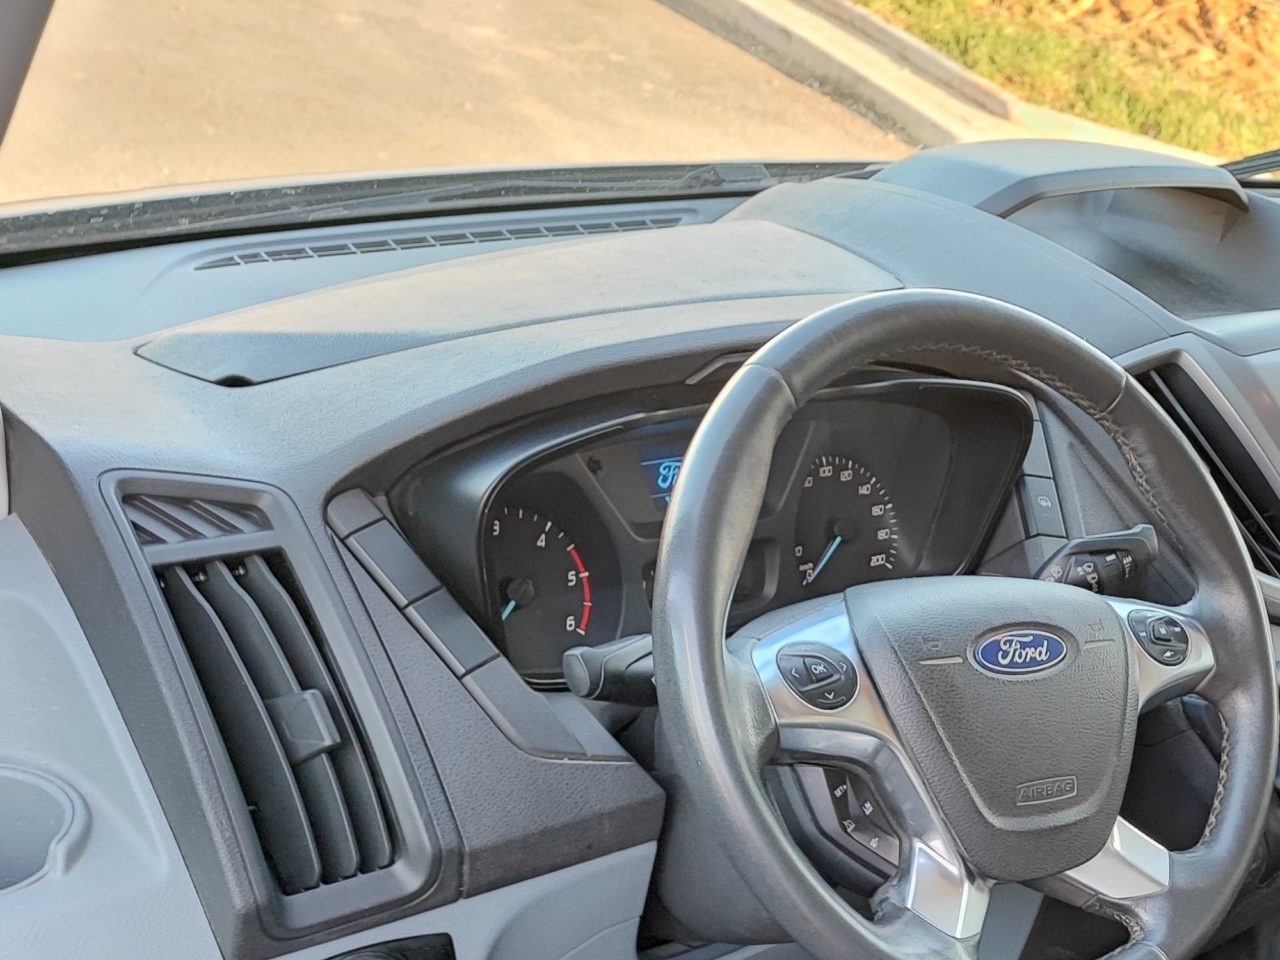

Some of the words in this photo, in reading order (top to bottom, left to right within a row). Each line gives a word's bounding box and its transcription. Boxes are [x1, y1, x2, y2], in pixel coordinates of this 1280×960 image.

[819, 465, 833, 477] 100
[492, 520, 500, 536] 3
[536, 533, 546, 548] 4
[870, 554, 886, 566] 200
[567, 570, 576, 586] 5
[566, 615, 575, 631] 6
[997, 634, 1051, 666] Ford
[811, 664, 828, 674] OK
[1018, 779, 1074, 801] AIRBAG
